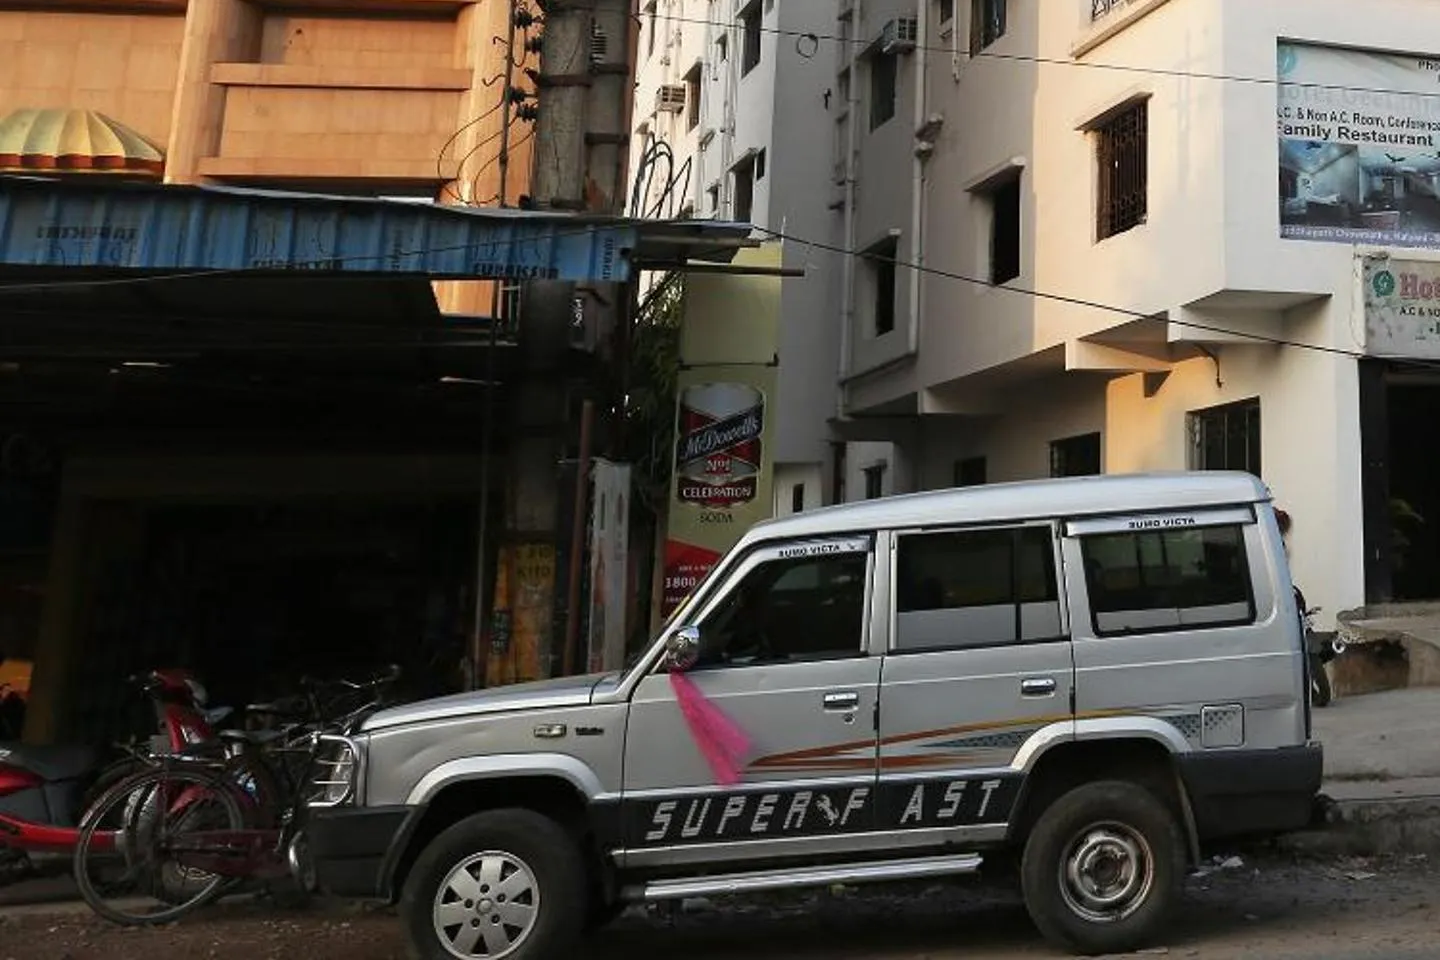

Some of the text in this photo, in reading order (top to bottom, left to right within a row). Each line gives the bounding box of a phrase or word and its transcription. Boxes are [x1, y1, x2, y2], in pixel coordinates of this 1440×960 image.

[1306, 109, 1328, 123] Non
[1337, 125, 1435, 147] Restaurant
[682, 486, 751, 499] CELEBRATION
[700, 513, 733, 524] SODA
[1128, 517, 1195, 529] SUMO VICTA
[778, 544, 840, 558] SUMO VICTA
[645, 790, 812, 840] SUPER
